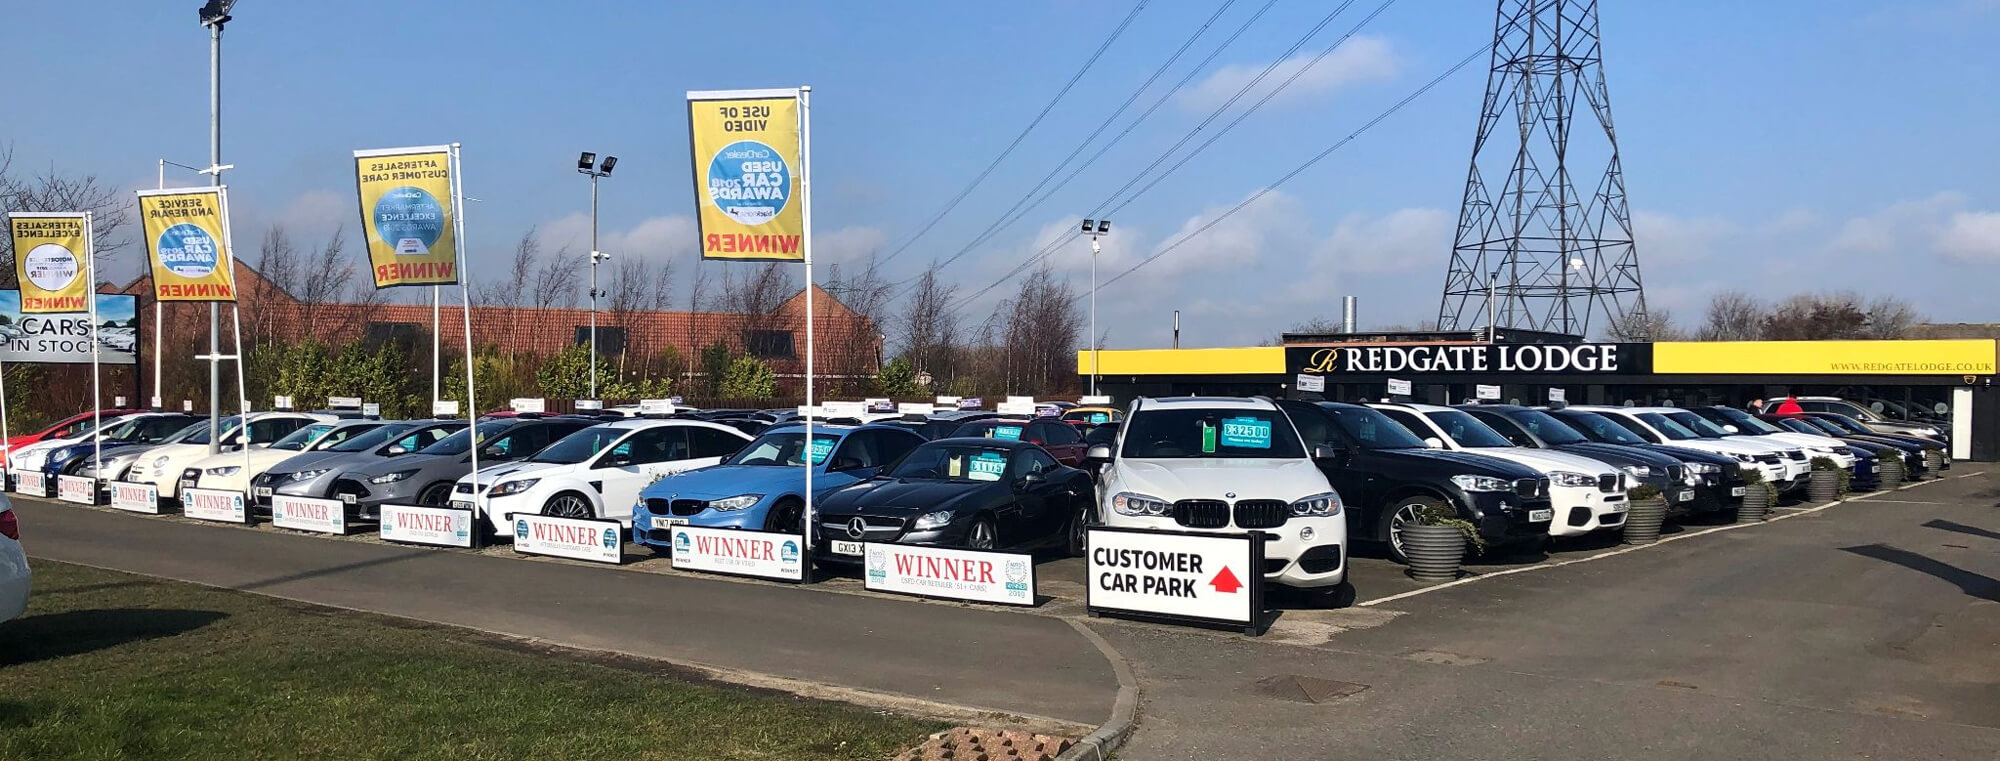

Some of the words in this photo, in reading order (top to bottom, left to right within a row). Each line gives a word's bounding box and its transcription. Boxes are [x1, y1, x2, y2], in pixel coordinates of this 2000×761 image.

[22, 318, 89, 336] CARS
[11, 339, 30, 352] IN
[1346, 346, 1488, 372] REDGATE
[1498, 345, 1618, 372] LODGE
[1831, 362, 1992, 371] WWW.REDGATELODGE.CO.UK
[1225, 424, 1269, 437] £32500
[119, 487, 148, 503] WINNER
[194, 494, 233, 511] WINNER
[285, 501, 329, 520] WINNER
[397, 512, 452, 533] WINNER
[533, 522, 599, 546] WINNER
[696, 535, 776, 561] WINNER
[838, 542, 856, 552] GX13
[894, 553, 996, 584] WINNER
[1093, 547, 1203, 574] CUSTOMER
[1100, 572, 1138, 593] CAR
[1143, 575, 1197, 599] PARK
